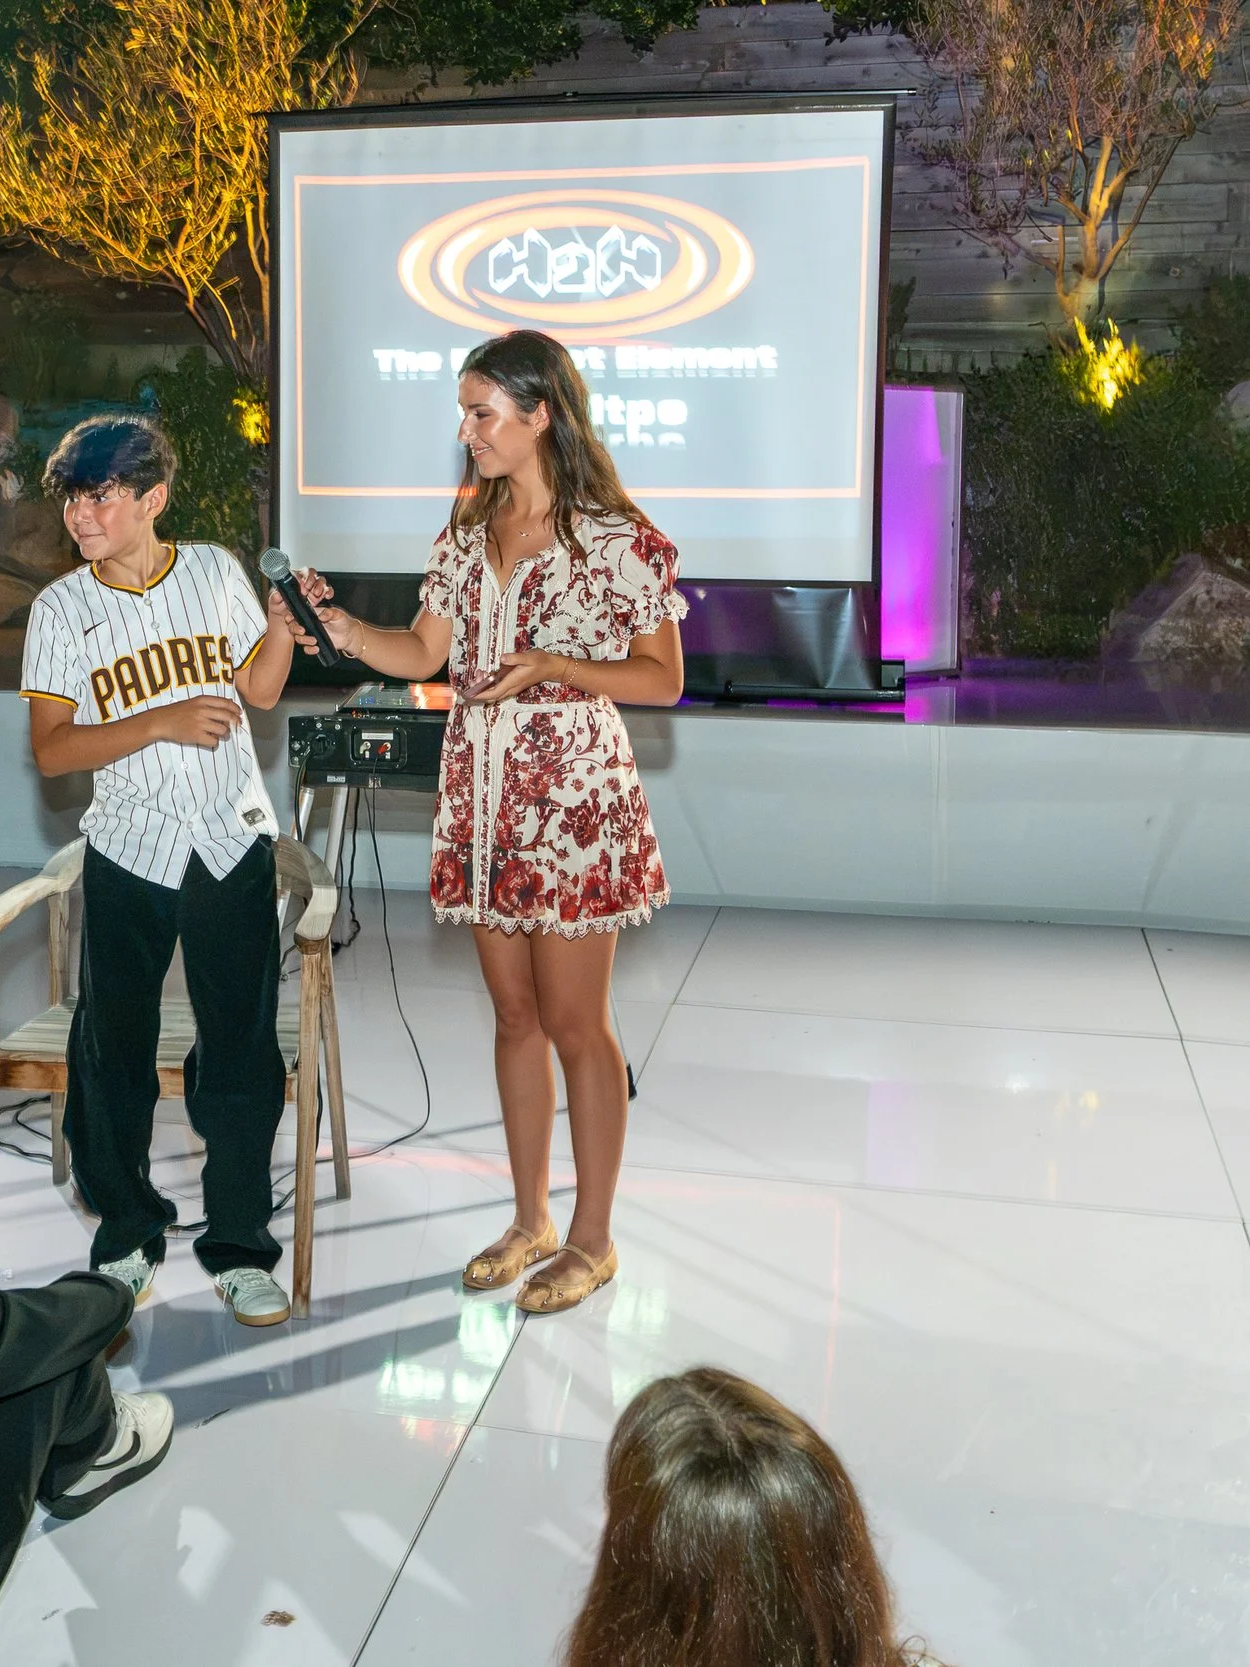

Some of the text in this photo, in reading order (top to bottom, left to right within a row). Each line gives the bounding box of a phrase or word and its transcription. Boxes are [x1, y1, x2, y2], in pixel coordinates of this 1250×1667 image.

[372, 348, 443, 373] The
[615, 344, 778, 370] Element
[90, 634, 235, 724] PADRES
